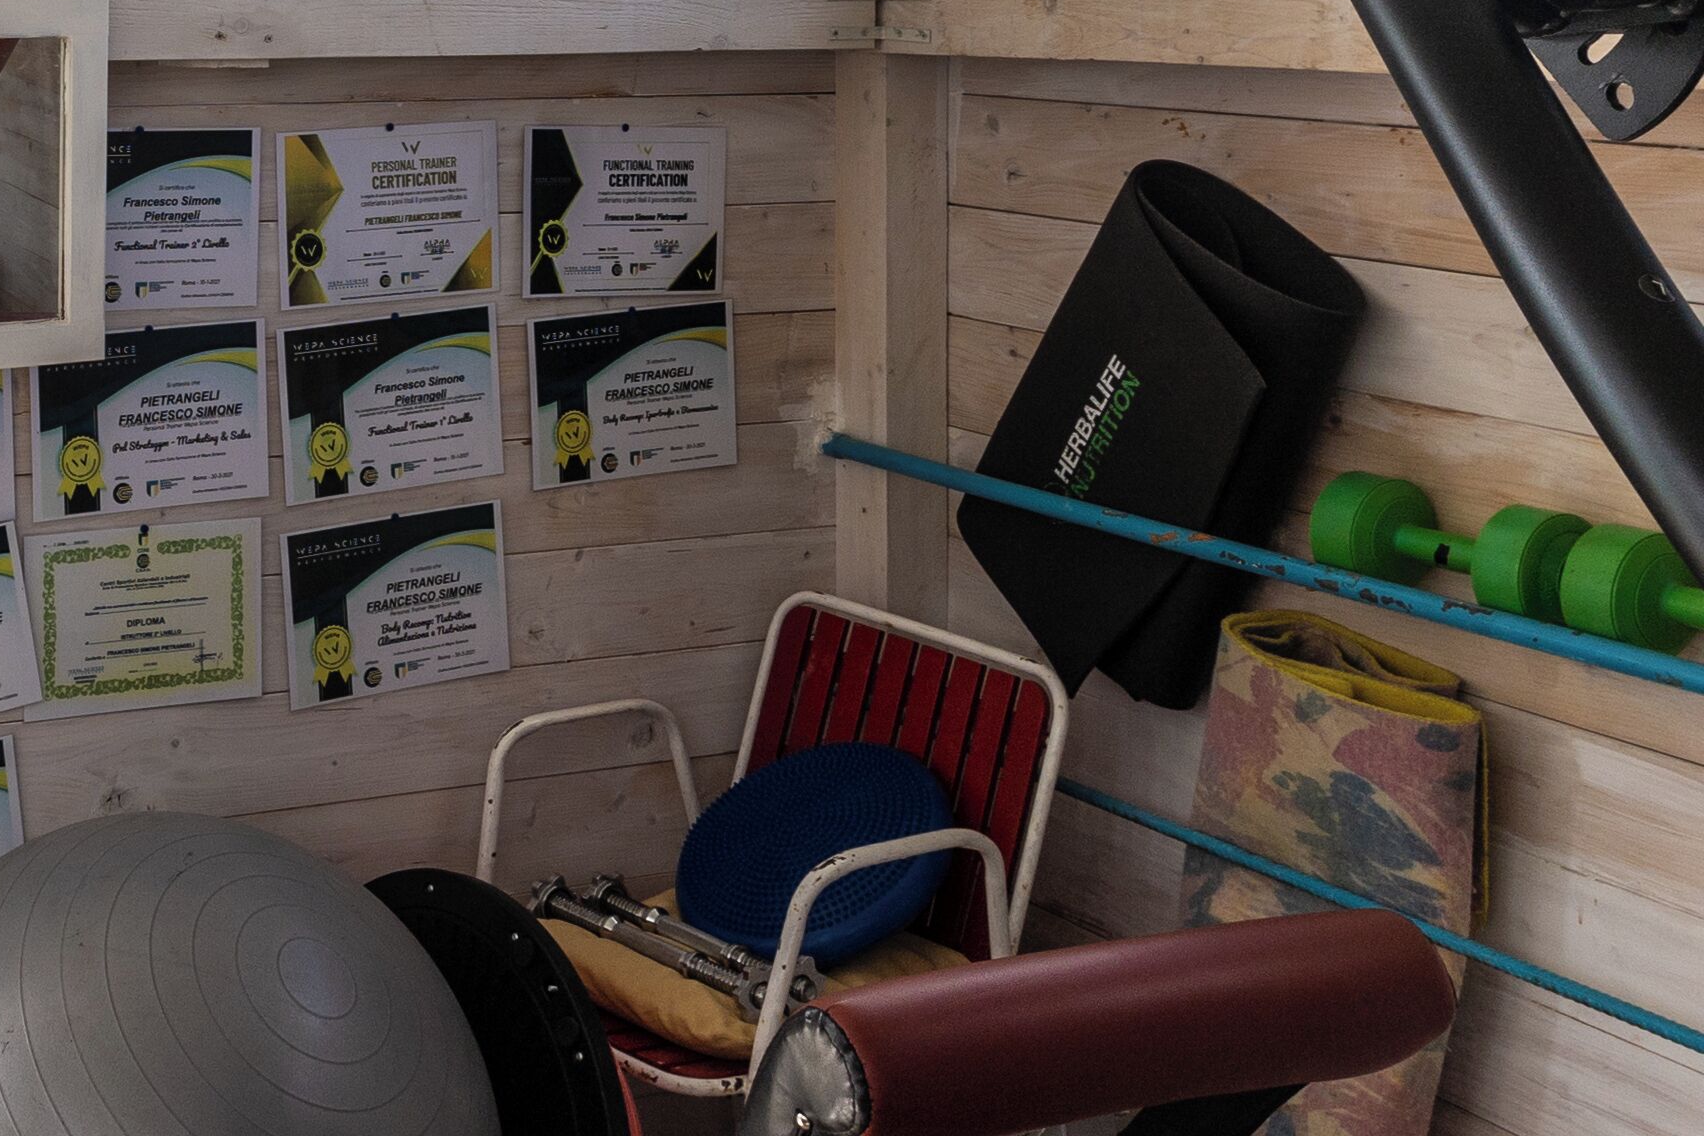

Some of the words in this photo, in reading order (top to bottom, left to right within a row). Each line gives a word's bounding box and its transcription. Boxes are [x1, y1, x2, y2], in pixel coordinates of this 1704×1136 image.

[371, 159, 417, 173] PERSONAL
[420, 156, 457, 170] TRAINER
[603, 160, 654, 172] FUNCTIONAL
[656, 160, 694, 171] TRAINING
[372, 171, 457, 190] CERTIFICATION
[609, 174, 688, 187] CERTIFICATION
[123, 197, 178, 207] Francesco
[181, 195, 221, 206] Simone
[144, 210, 200, 222] Pietrangeli
[364, 216, 404, 226] PIETRANGELI
[405, 212, 439, 223] FRANCESCO
[441, 210, 462, 219] SIMONE
[657, 213, 688, 222] Pietrangeli
[114, 239, 157, 252] Functional
[159, 240, 189, 250] Trainer
[203, 237, 229, 249] Livello
[542, 332, 570, 340] WEPA
[578, 325, 620, 337] SCIENCE
[293, 341, 326, 351] WEPA
[332, 333, 378, 346] SCIENCE
[624, 366, 693, 383] PIETRANGELI
[375, 379, 426, 394] Francesco
[428, 374, 465, 387] Simone
[605, 386, 670, 401] FRANCESCO
[673, 378, 714, 392] SIMONE
[140, 390, 220, 408] PIETRANGELI
[395, 389, 447, 407] Pietrangeli
[118, 410, 192, 426] FRANCESCO
[196, 403, 243, 418] SIMONE
[603, 416, 618, 426] Body
[1054, 354, 1126, 484] HERBALIFE
[368, 424, 408, 437] Functional
[409, 419, 438, 431] Trainer
[447, 412, 473, 424] Livello
[176, 433, 219, 446] Marketing
[220, 431, 229, 441] &
[230, 429, 252, 440] Sales
[1071, 370, 1140, 499] NUTRITION
[296, 545, 327, 555] WEPA
[335, 534, 381, 548] SCIENCE
[386, 572, 460, 594] PIETRANGELI
[366, 591, 436, 613] FRANCESCO
[438, 583, 482, 599] SIMONE
[126, 617, 165, 628] DIPLOMA
[381, 621, 401, 635] Body
[435, 610, 471, 624] Nutrition
[121, 632, 153, 640] ISTRUTTORE
[377, 629, 429, 647] Alimentazione
[436, 623, 476, 635] Nutrizione
[107, 648, 139, 656] FRANCESCO
[161, 642, 195, 651] PIETRANGELI
